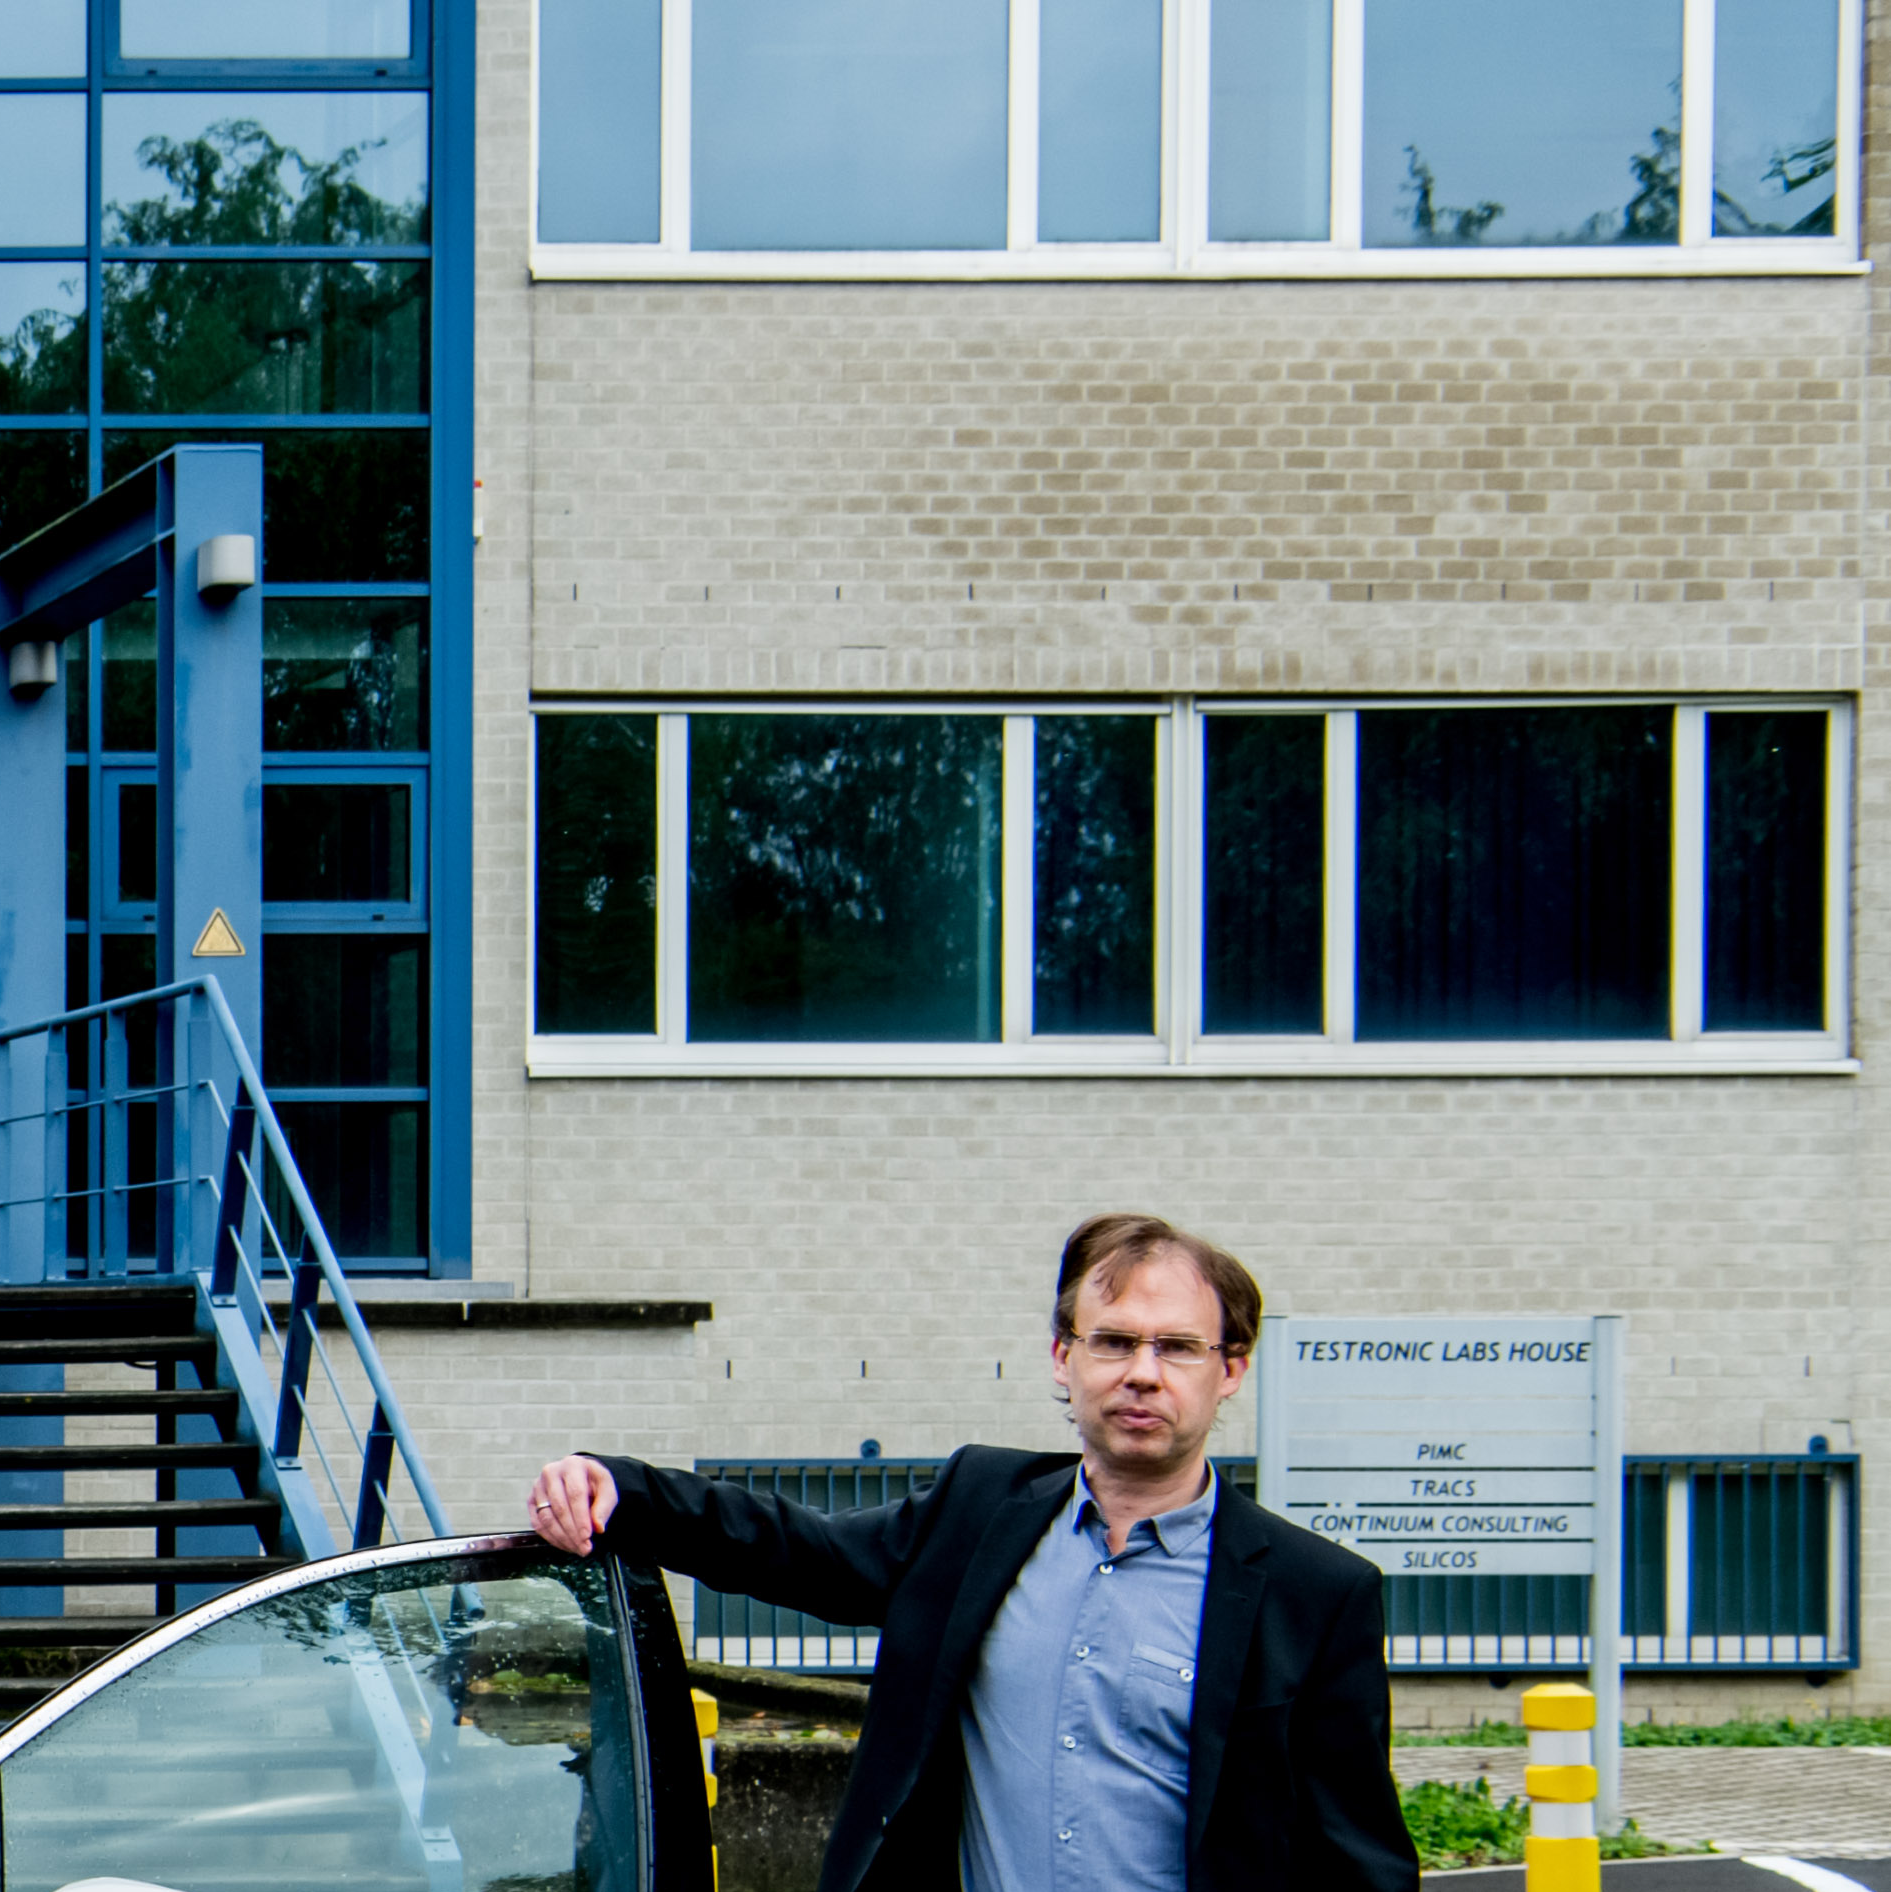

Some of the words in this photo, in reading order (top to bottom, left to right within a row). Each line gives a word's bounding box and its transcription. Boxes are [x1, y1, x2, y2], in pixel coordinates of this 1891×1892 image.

[1296, 1341, 1433, 1362] TESTRONIC
[1441, 1341, 1500, 1362] LABS
[1507, 1342, 1591, 1362] HOUSE
[1416, 1443, 1467, 1461] PIMC
[1410, 1479, 1476, 1497] TRACS
[1310, 1514, 1435, 1533] CONTINUUM
[1441, 1515, 1569, 1533] CONSULTING
[1402, 1550, 1478, 1569] SILICOS
